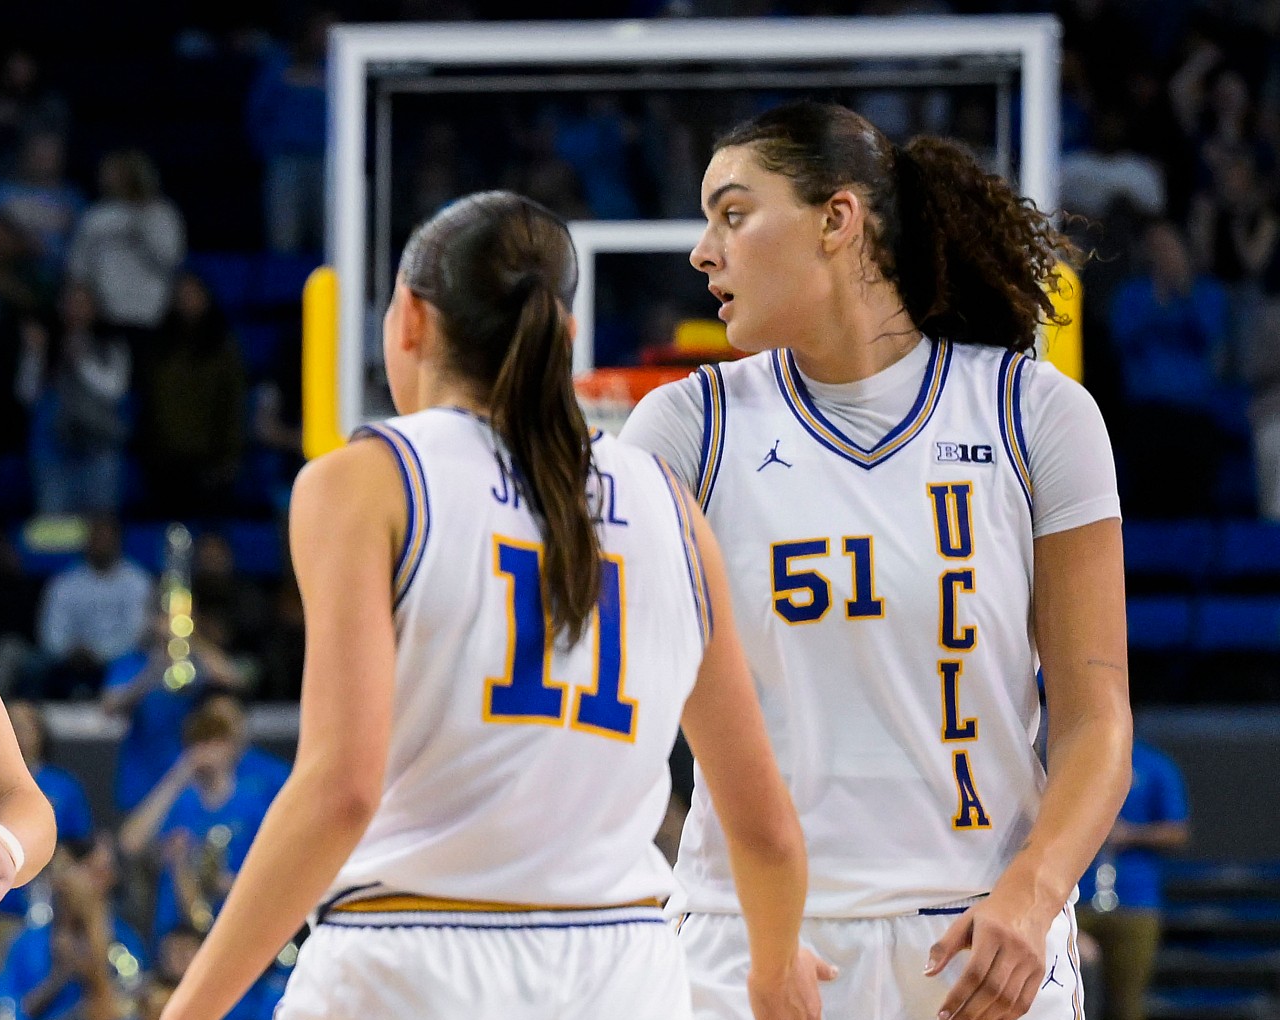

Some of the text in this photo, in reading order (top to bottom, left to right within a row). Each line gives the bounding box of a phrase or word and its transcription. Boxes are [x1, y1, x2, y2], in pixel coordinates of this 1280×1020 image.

[482, 532, 639, 744] 11
[770, 535, 885, 626] 51
[926, 480, 992, 830] UCLA
